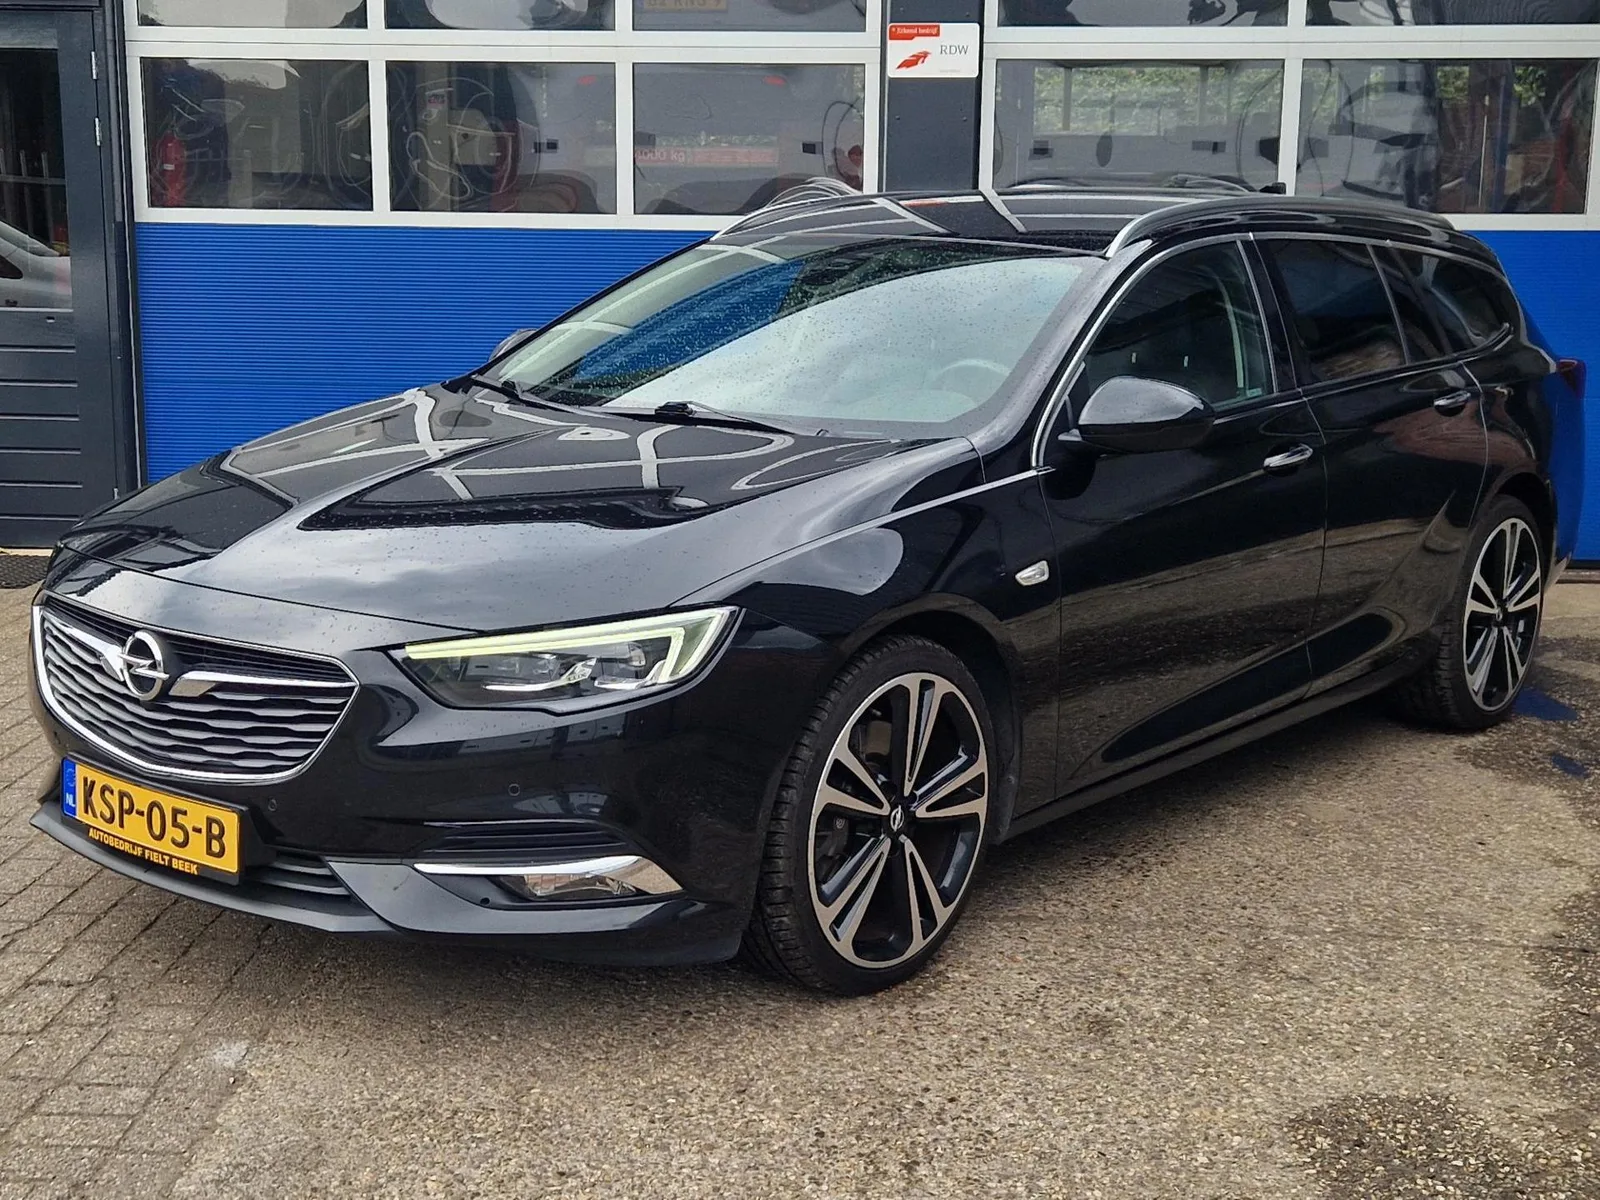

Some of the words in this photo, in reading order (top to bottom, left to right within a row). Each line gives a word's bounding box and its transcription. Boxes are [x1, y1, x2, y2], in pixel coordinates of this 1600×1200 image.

[940, 45, 969, 55] RDW
[65, 792, 76, 807] NL
[83, 776, 226, 858] KSP-05-B
[88, 827, 144, 856] AUTOBEDRIJF
[145, 849, 170, 866] FIELT
[172, 857, 199, 875] BEEK
